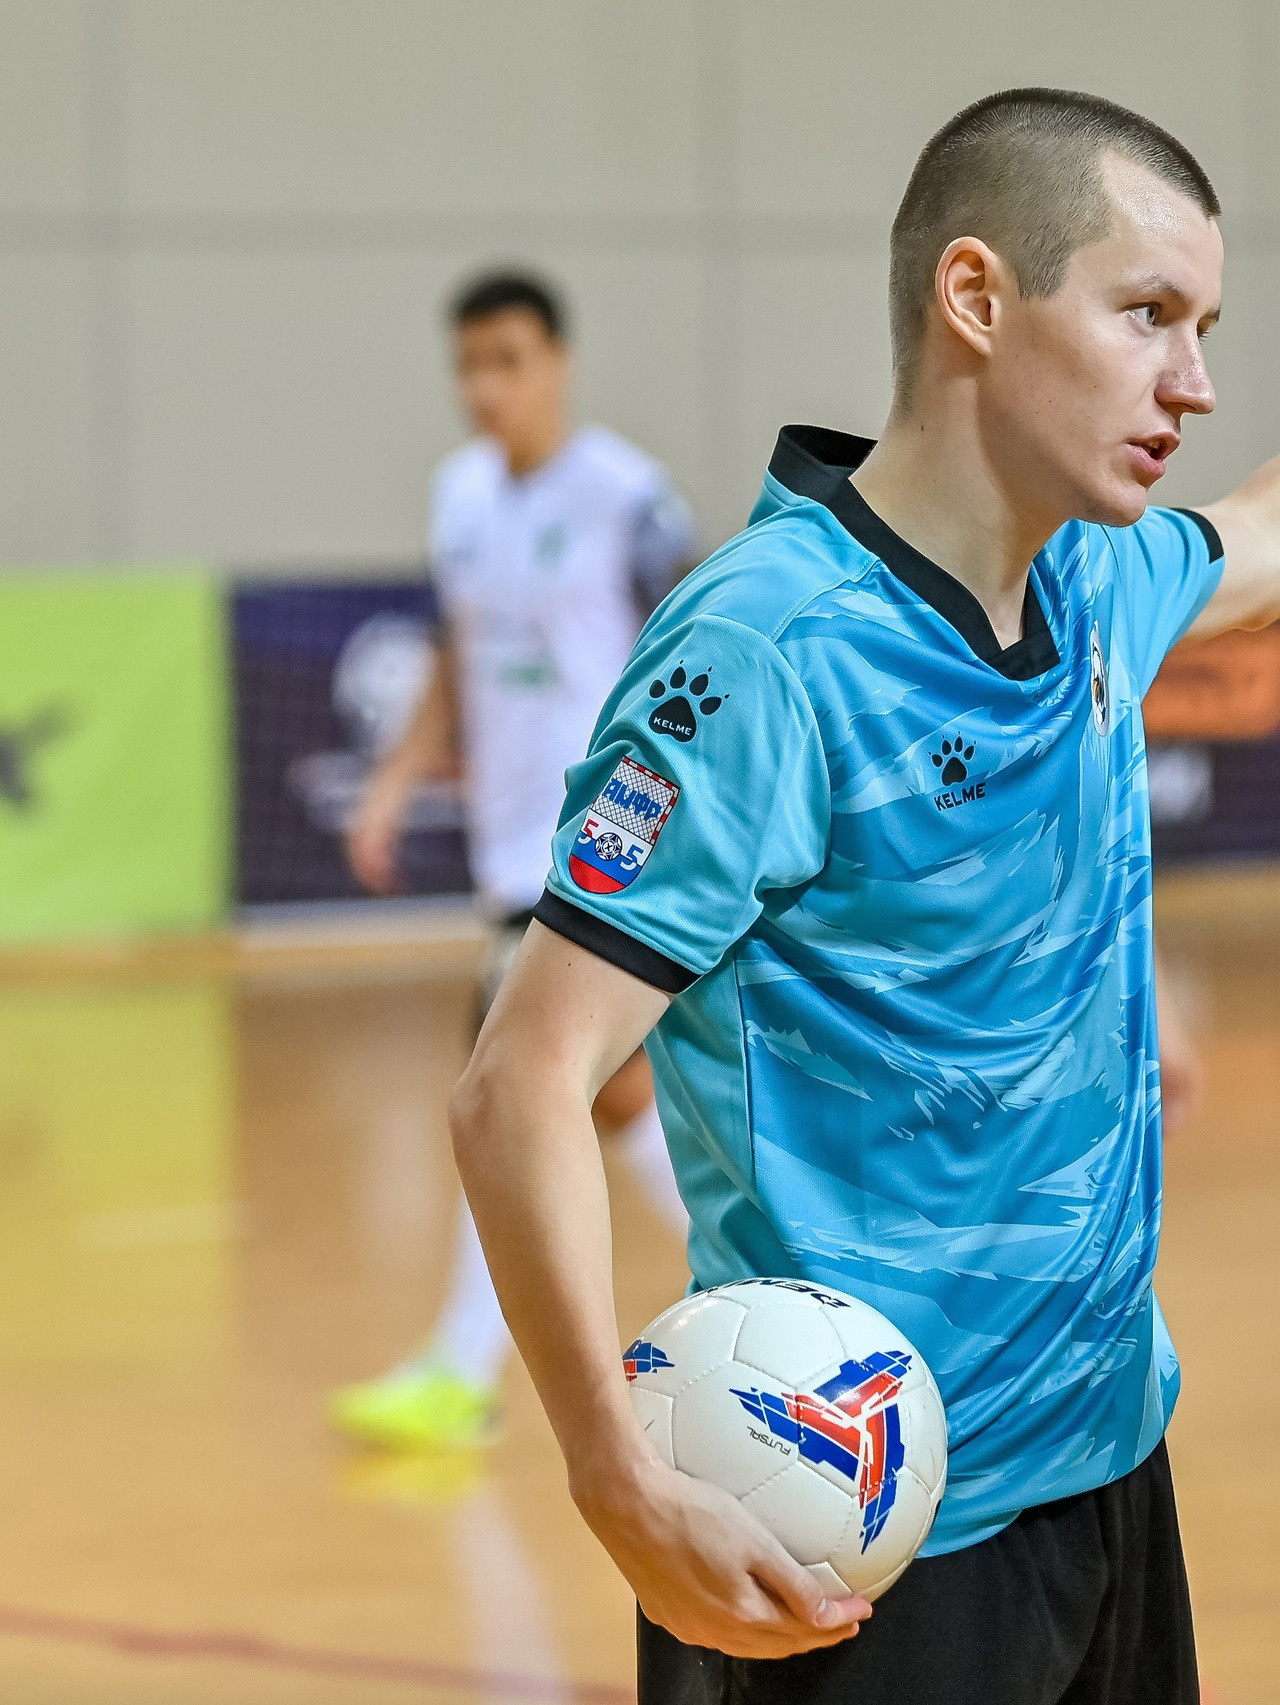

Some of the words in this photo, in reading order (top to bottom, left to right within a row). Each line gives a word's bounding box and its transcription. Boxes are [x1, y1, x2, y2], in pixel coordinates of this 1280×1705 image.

[653, 716, 693, 736] KELME
[602, 778, 662, 821] АМФР
[933, 781, 987, 811] KELME
[578, 818, 599, 844] 5
[620, 844, 644, 870] 5
[746, 1425, 792, 1456] FUTSAL
